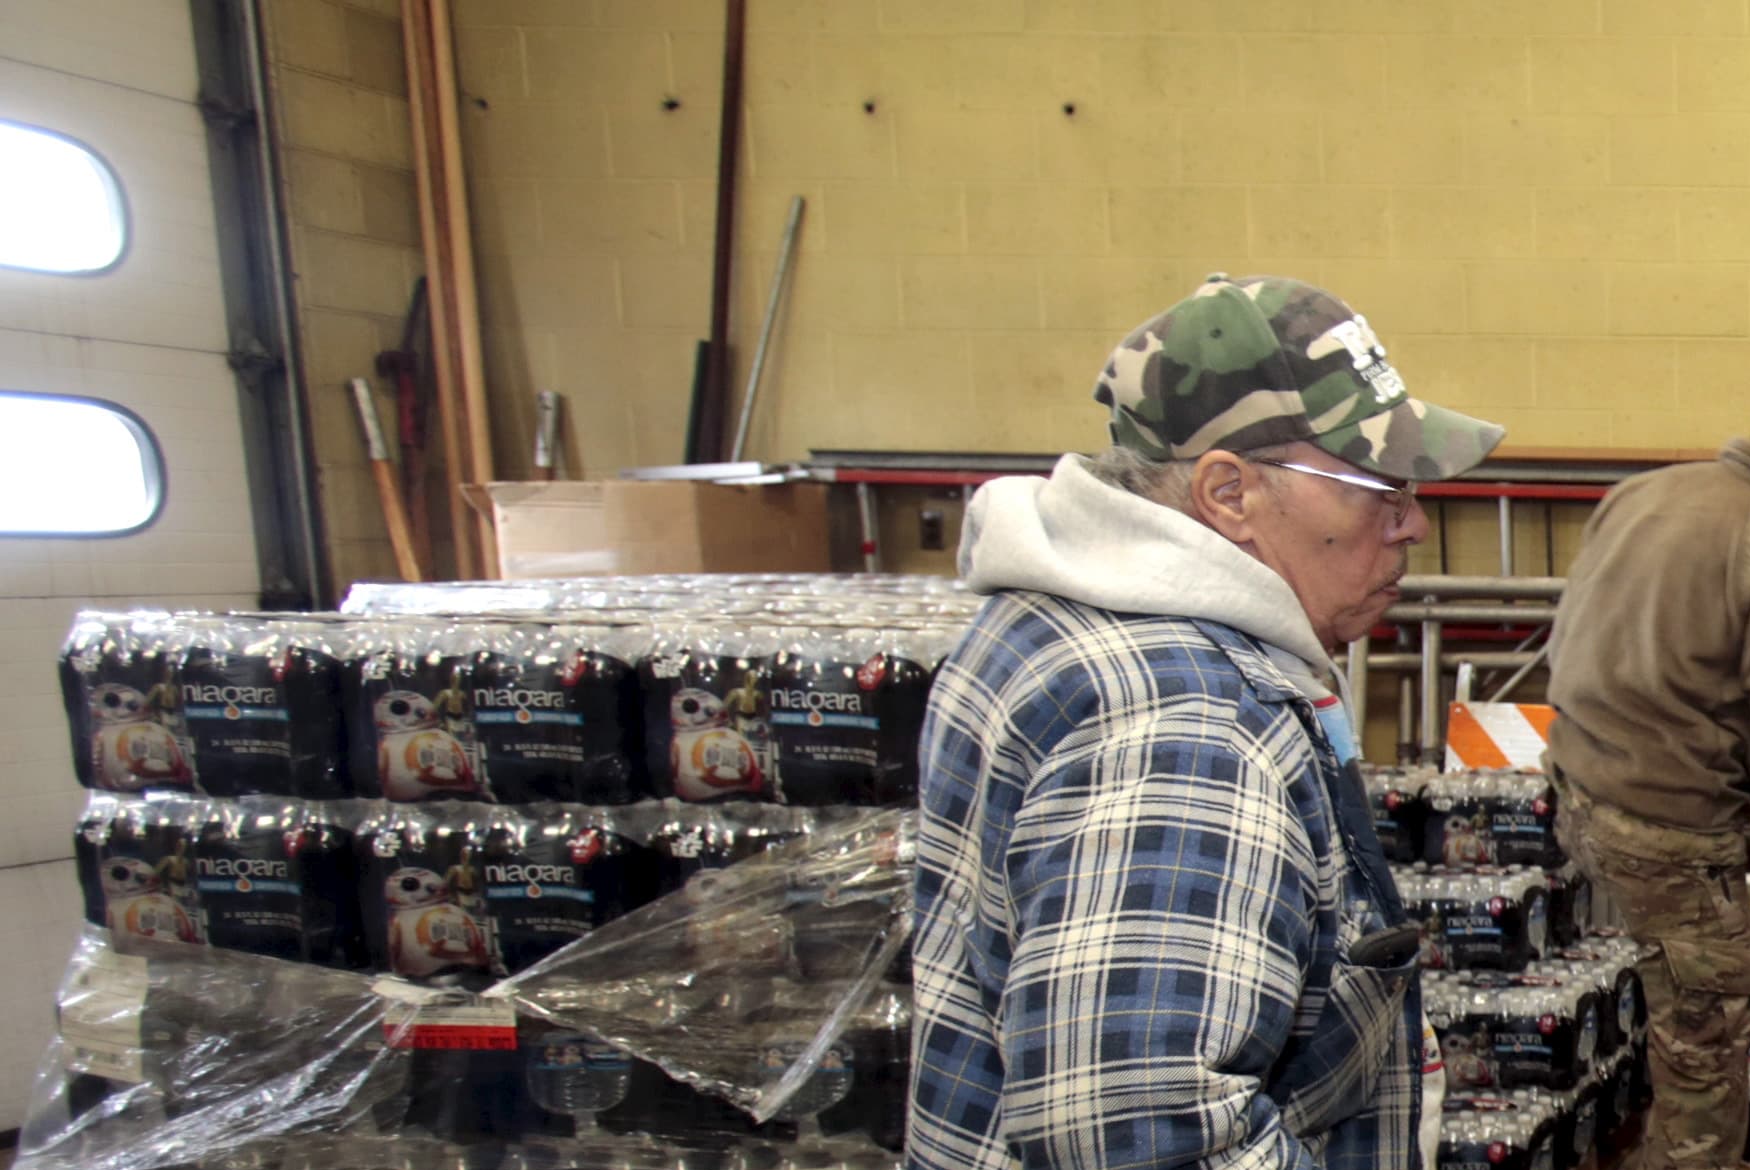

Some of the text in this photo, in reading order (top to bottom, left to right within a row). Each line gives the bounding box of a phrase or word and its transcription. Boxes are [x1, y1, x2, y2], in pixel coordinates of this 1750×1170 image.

[183, 684, 277, 719] niagara
[474, 687, 565, 723] niagara
[771, 687, 862, 725] niagara
[195, 857, 288, 892] niagara
[485, 863, 575, 898] niagara
